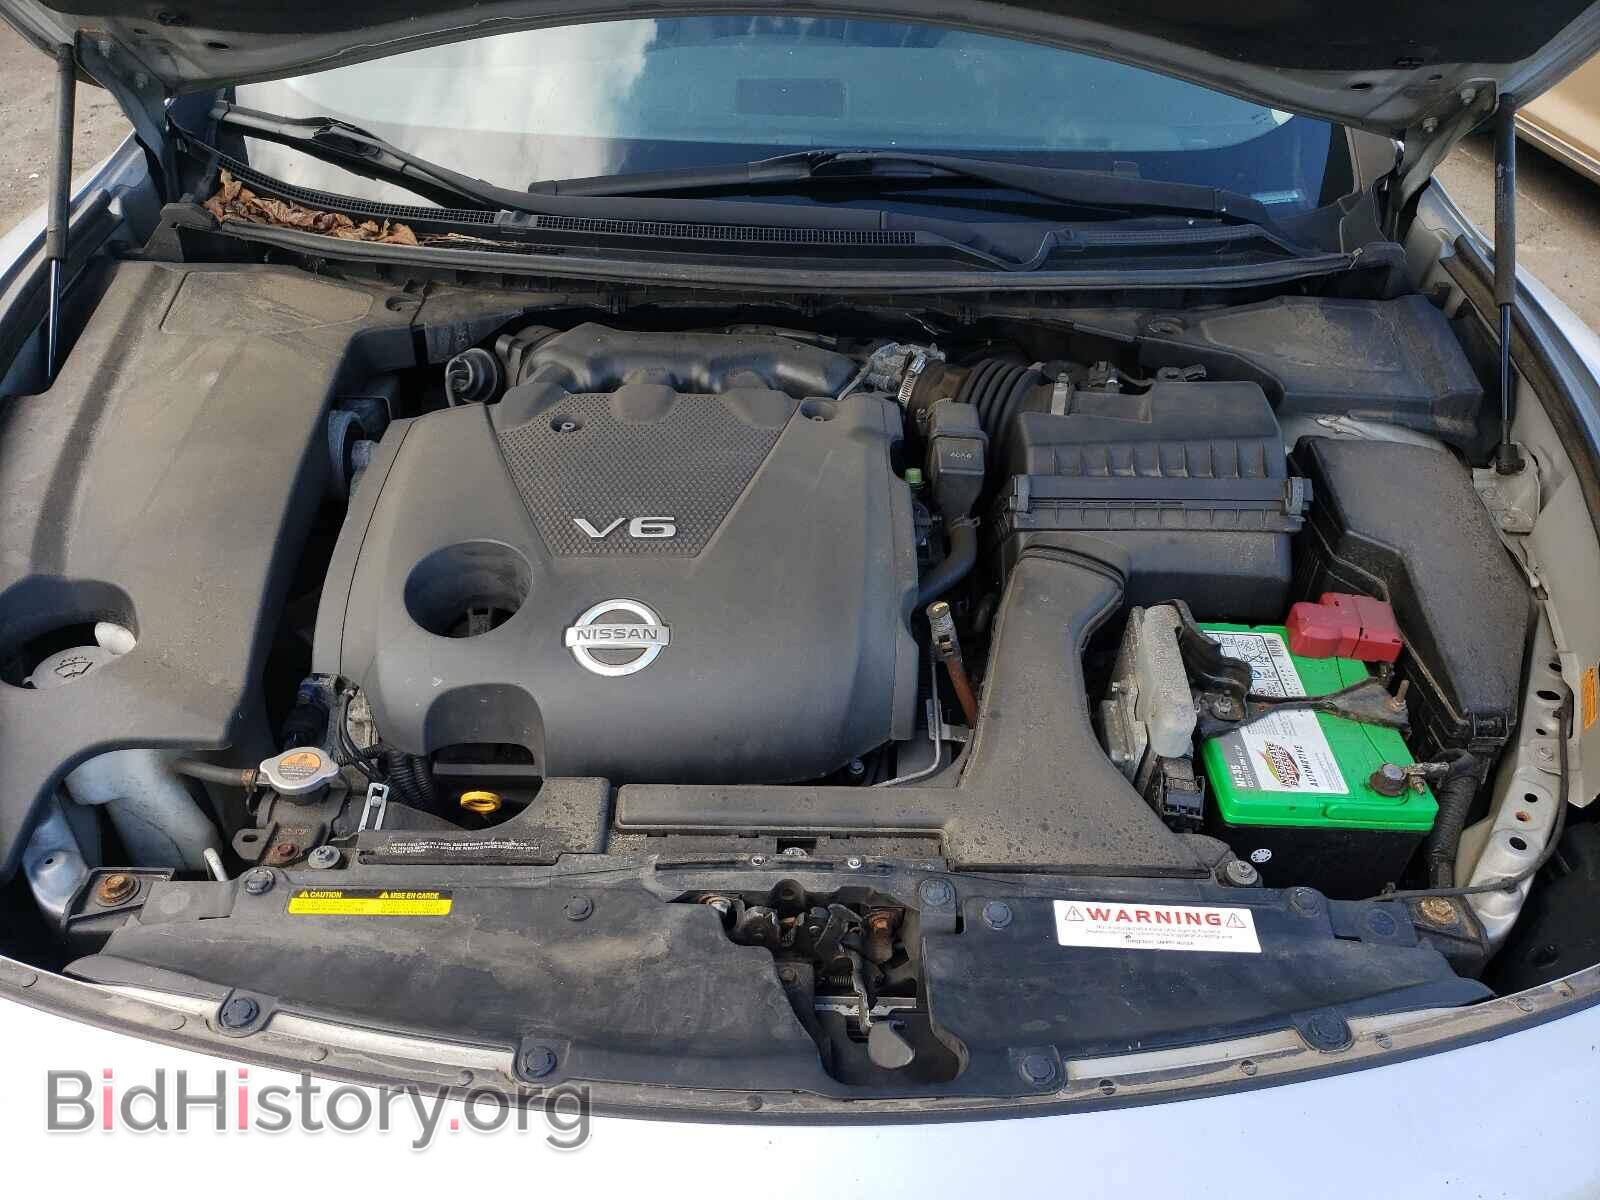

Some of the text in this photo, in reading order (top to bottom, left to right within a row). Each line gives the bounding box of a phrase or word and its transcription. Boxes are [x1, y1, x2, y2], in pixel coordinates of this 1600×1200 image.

[573, 517, 677, 538] V6
[576, 628, 658, 641] NISSAN
[1295, 744, 1319, 788] AUTOMOTIVE
[310, 891, 342, 899] CAUTION
[406, 892, 416, 900] EN
[416, 892, 440, 900] GARDE
[1086, 907, 1222, 926] WARNING
